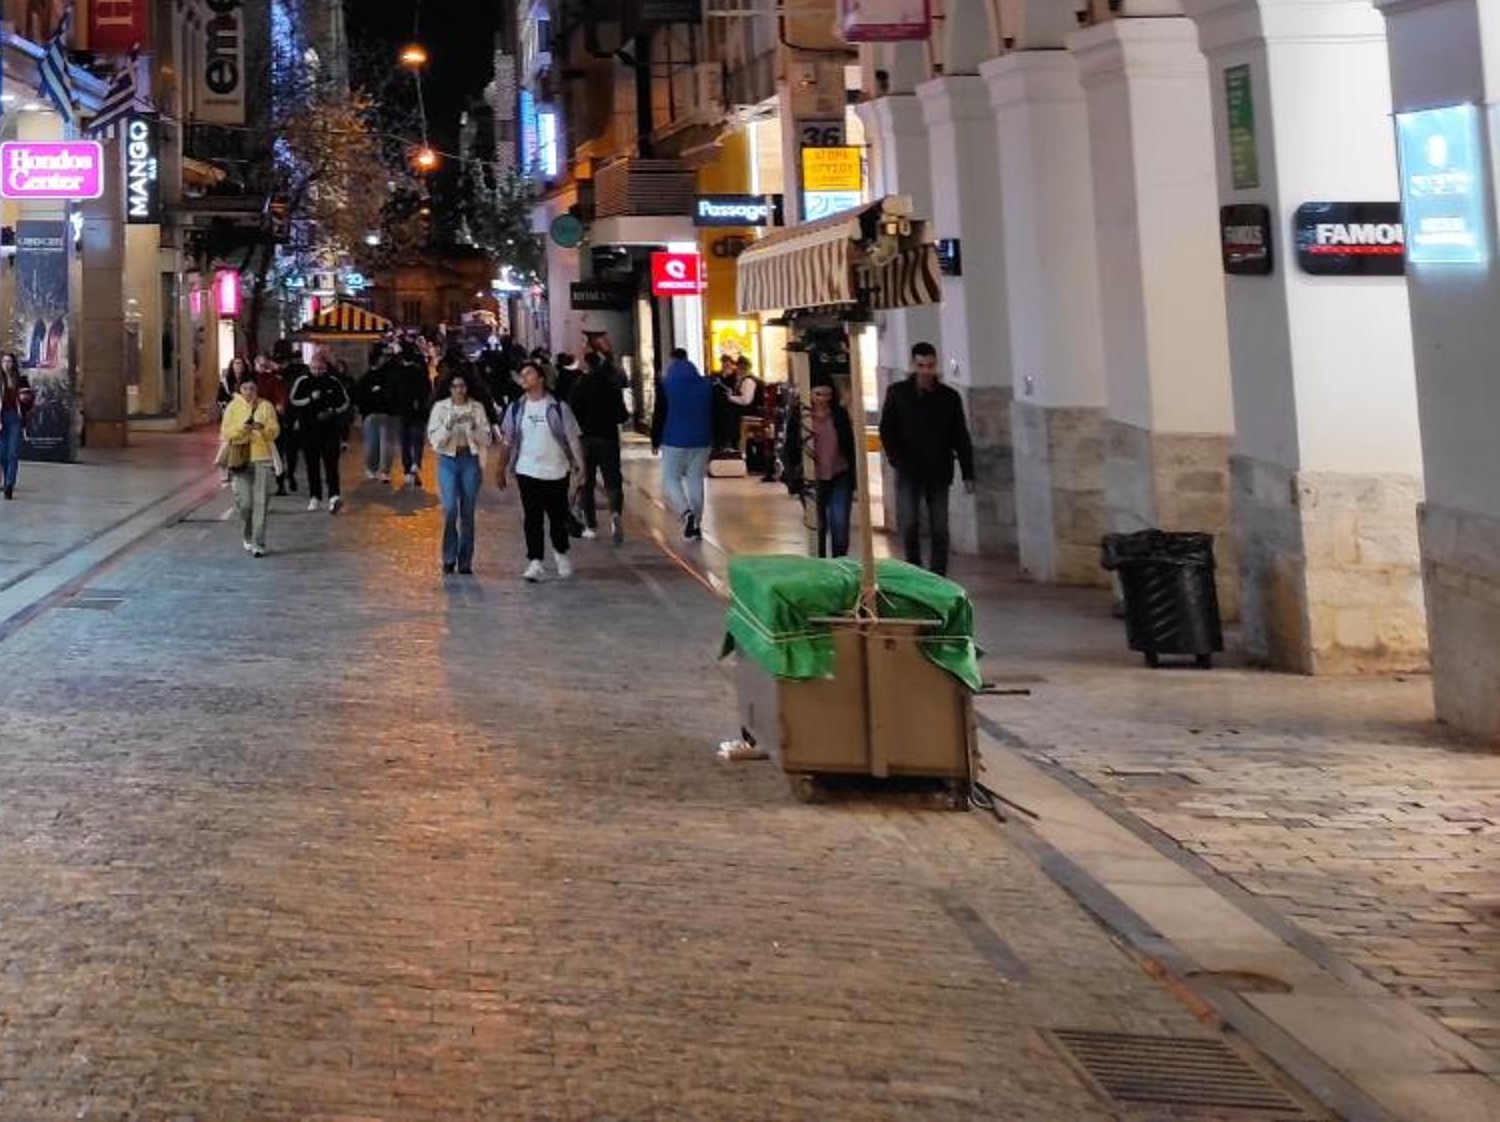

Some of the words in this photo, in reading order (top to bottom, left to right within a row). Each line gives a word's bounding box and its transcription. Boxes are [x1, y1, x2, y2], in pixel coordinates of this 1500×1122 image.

[9, 149, 93, 171] Hondos
[128, 121, 149, 216] MANGO
[9, 169, 85, 190] Center
